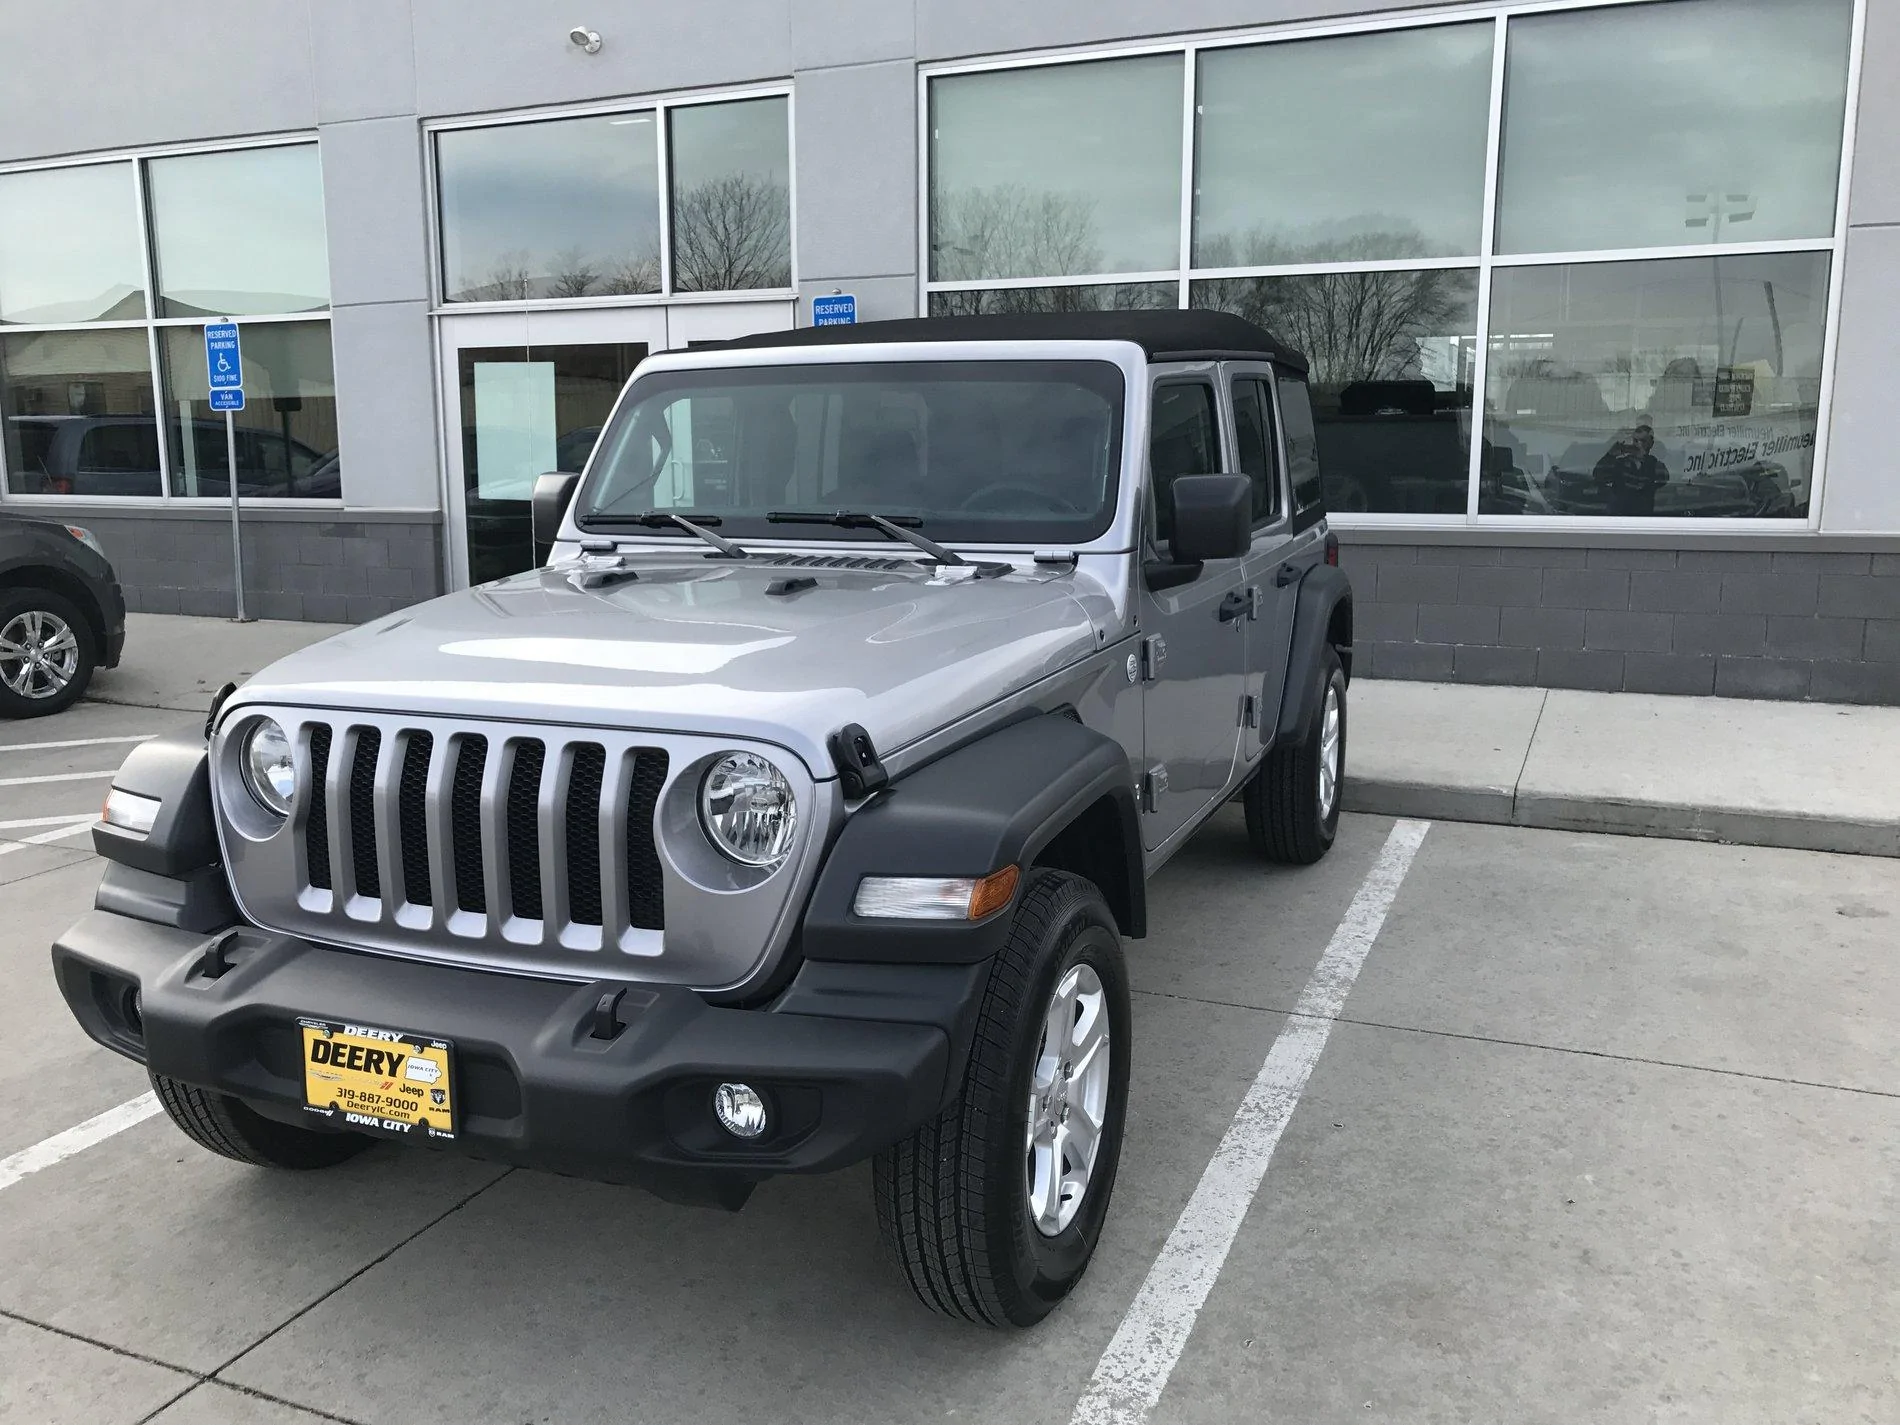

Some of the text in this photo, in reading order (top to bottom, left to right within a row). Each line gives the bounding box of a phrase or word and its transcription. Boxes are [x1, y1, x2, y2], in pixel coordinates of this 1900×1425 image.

[815, 303, 854, 315] RESERVED
[207, 329, 236, 339] RESERVED
[210, 341, 236, 350] PARKING
[226, 373, 238, 382] FINE
[344, 1025, 405, 1044] DEERY
[430, 1040, 448, 1050] Jeep
[311, 1038, 405, 1078] DEERY
[407, 1064, 424, 1072] IOWA
[399, 1083, 424, 1098] Jeep
[336, 1087, 419, 1112] 319-887-9000
[346, 1100, 411, 1120] DeeryIC.com
[428, 1106, 451, 1114] RAM
[345, 1112, 412, 1133] IOWA CITY
[436, 1131, 455, 1139] RAM
